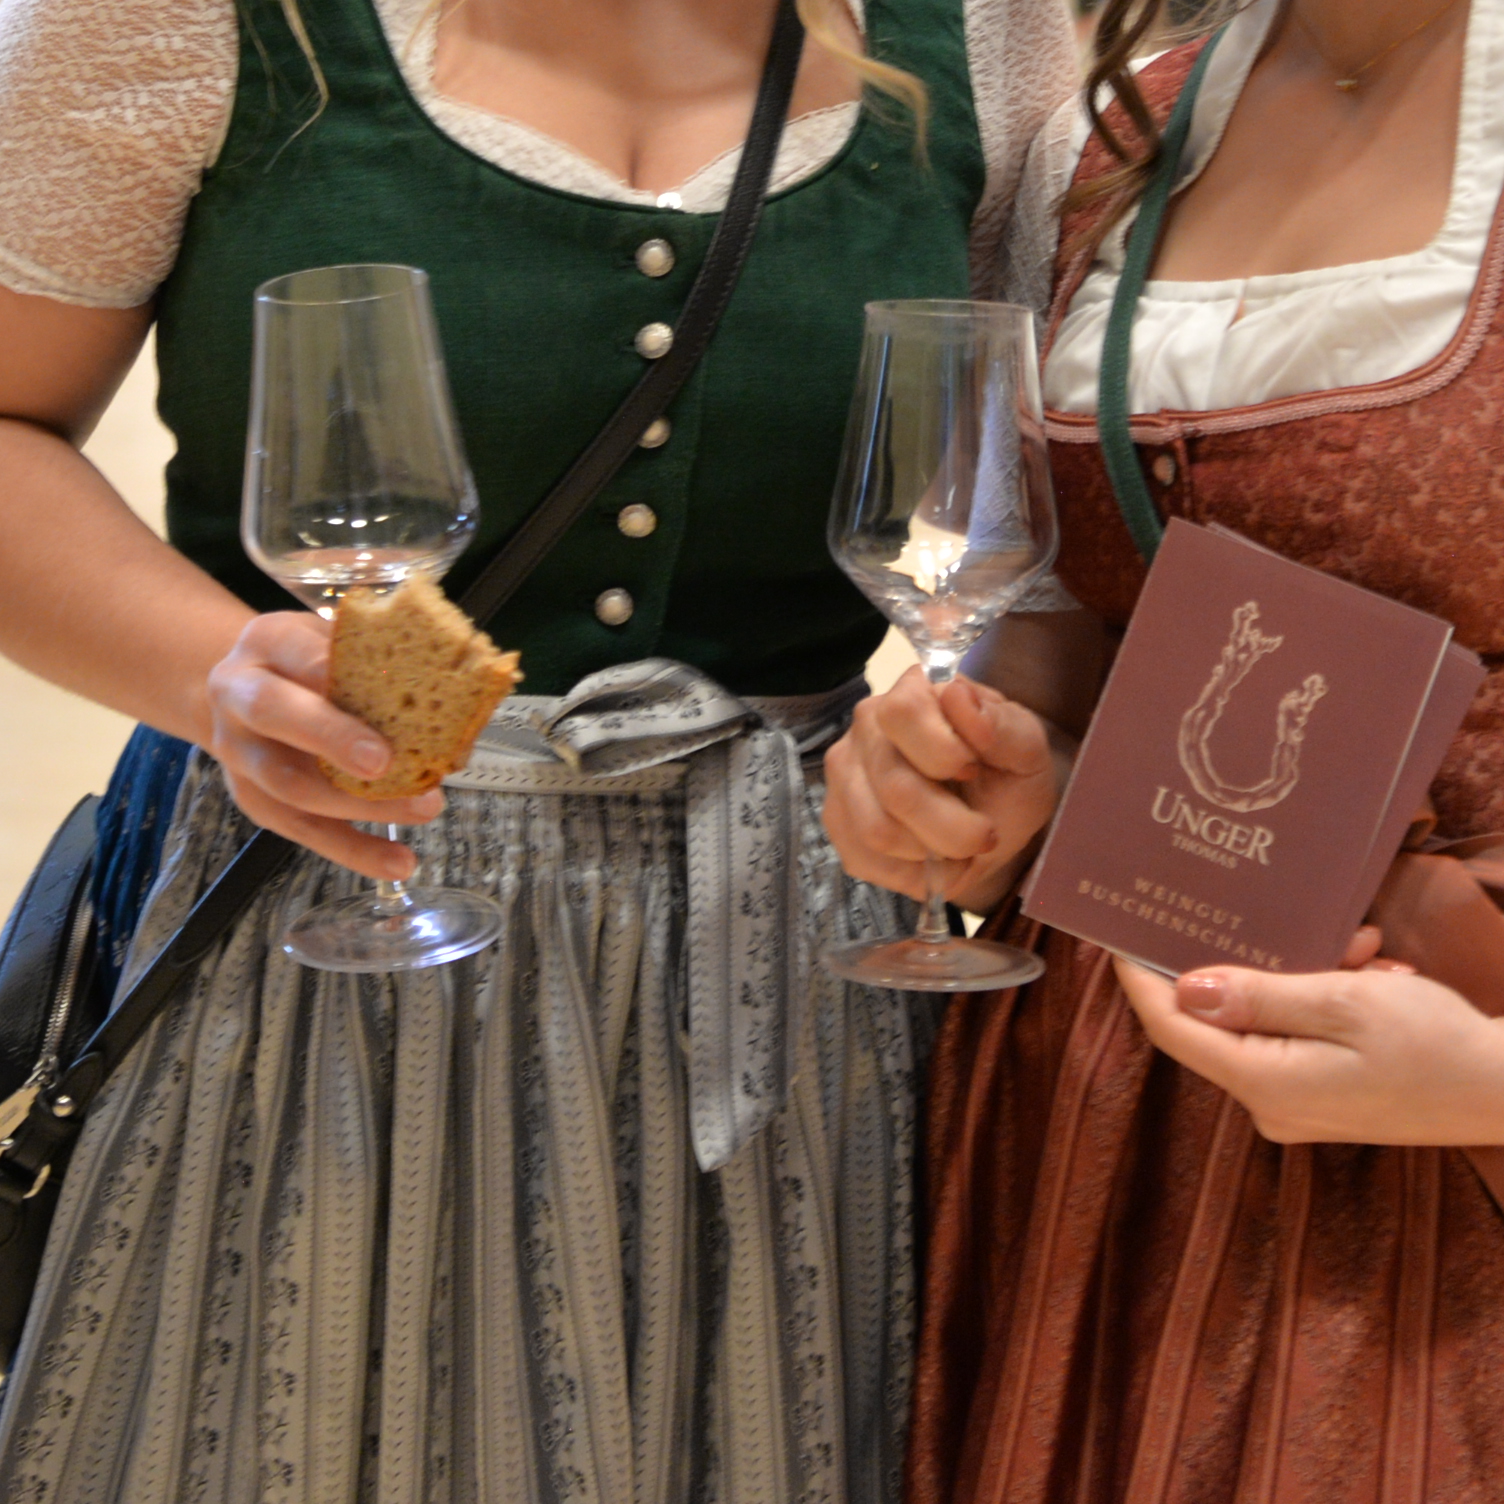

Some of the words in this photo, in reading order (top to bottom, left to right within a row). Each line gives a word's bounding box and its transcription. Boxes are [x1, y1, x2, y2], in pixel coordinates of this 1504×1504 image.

[1151, 786, 1274, 866] UNGER
[1172, 834, 1238, 869] THOMAS
[1077, 879, 1283, 971] BUSCHENSCHANK
[1134, 877, 1243, 930] WEINGUT
